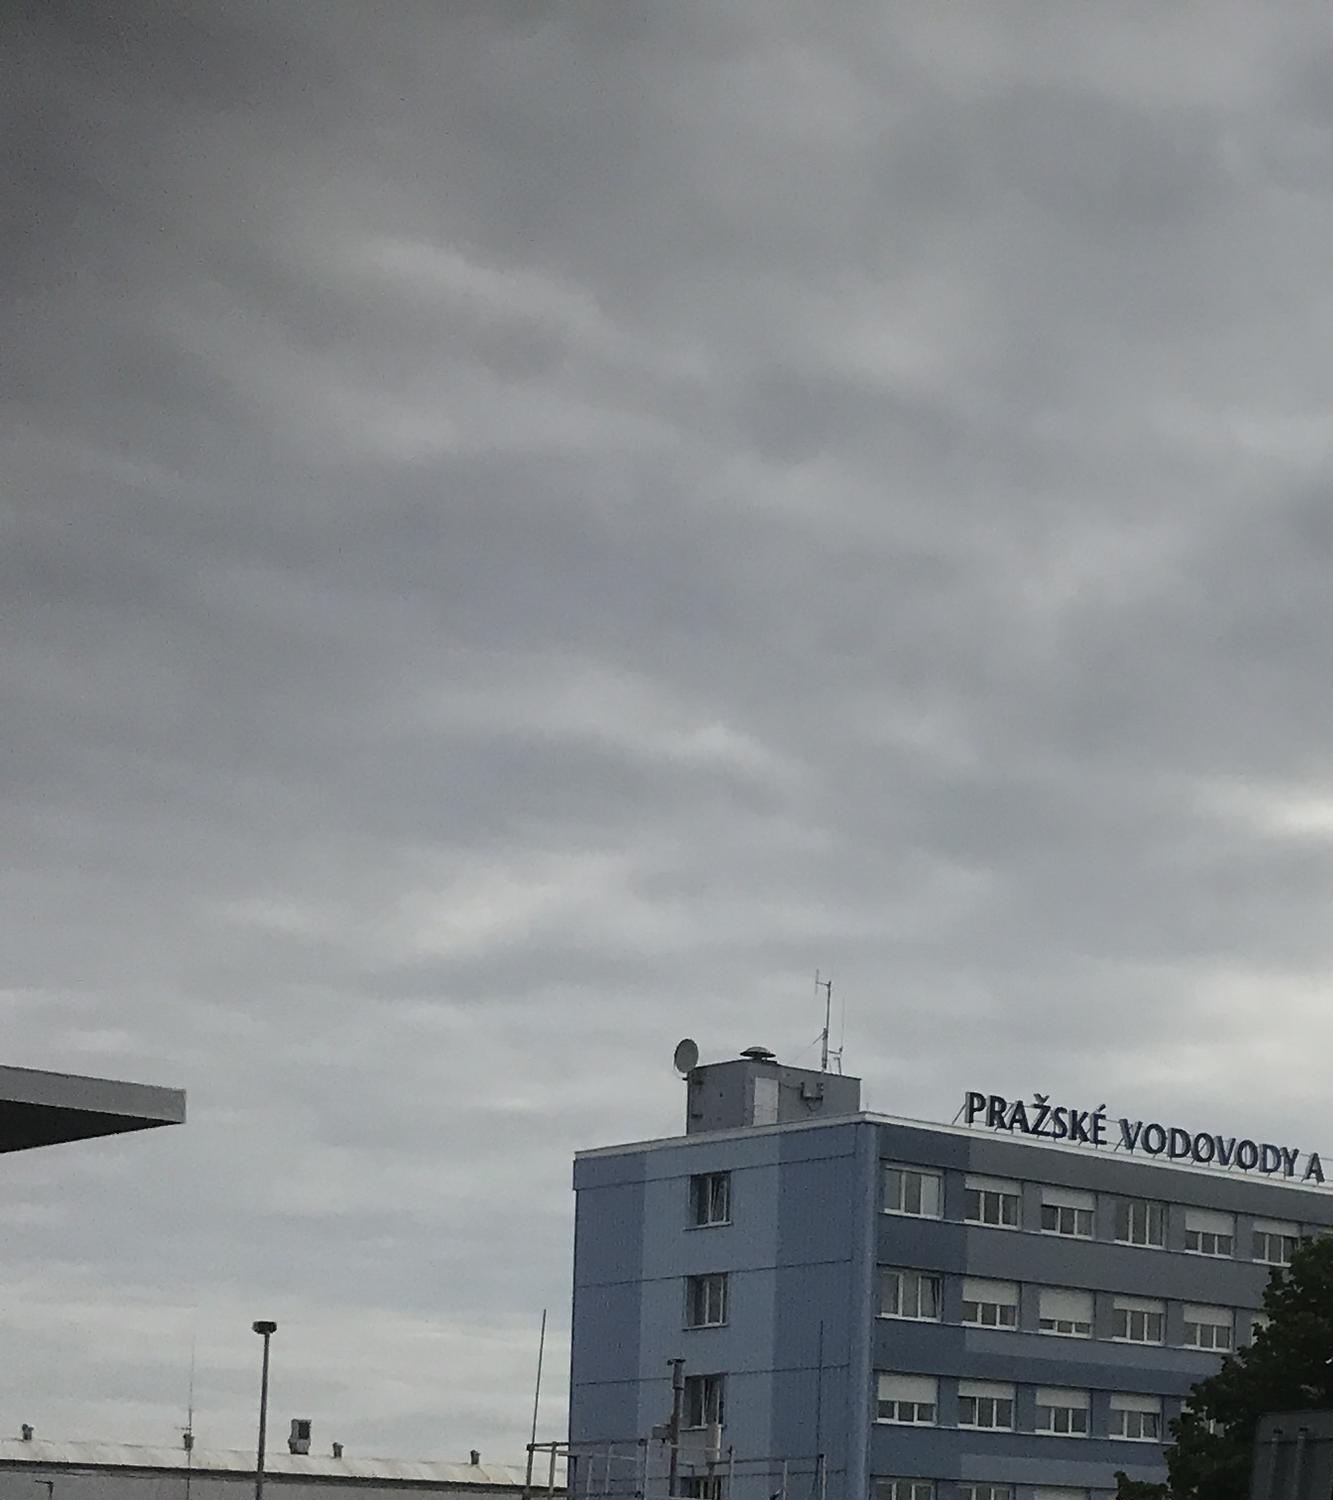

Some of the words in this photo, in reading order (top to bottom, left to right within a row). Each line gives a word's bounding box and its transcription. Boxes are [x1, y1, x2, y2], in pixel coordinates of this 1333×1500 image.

[964, 1091, 1107, 1146] PRAŽSKÉ
[1119, 1118, 1300, 1177] VODOVODY
[1305, 1152, 1325, 1183] A
